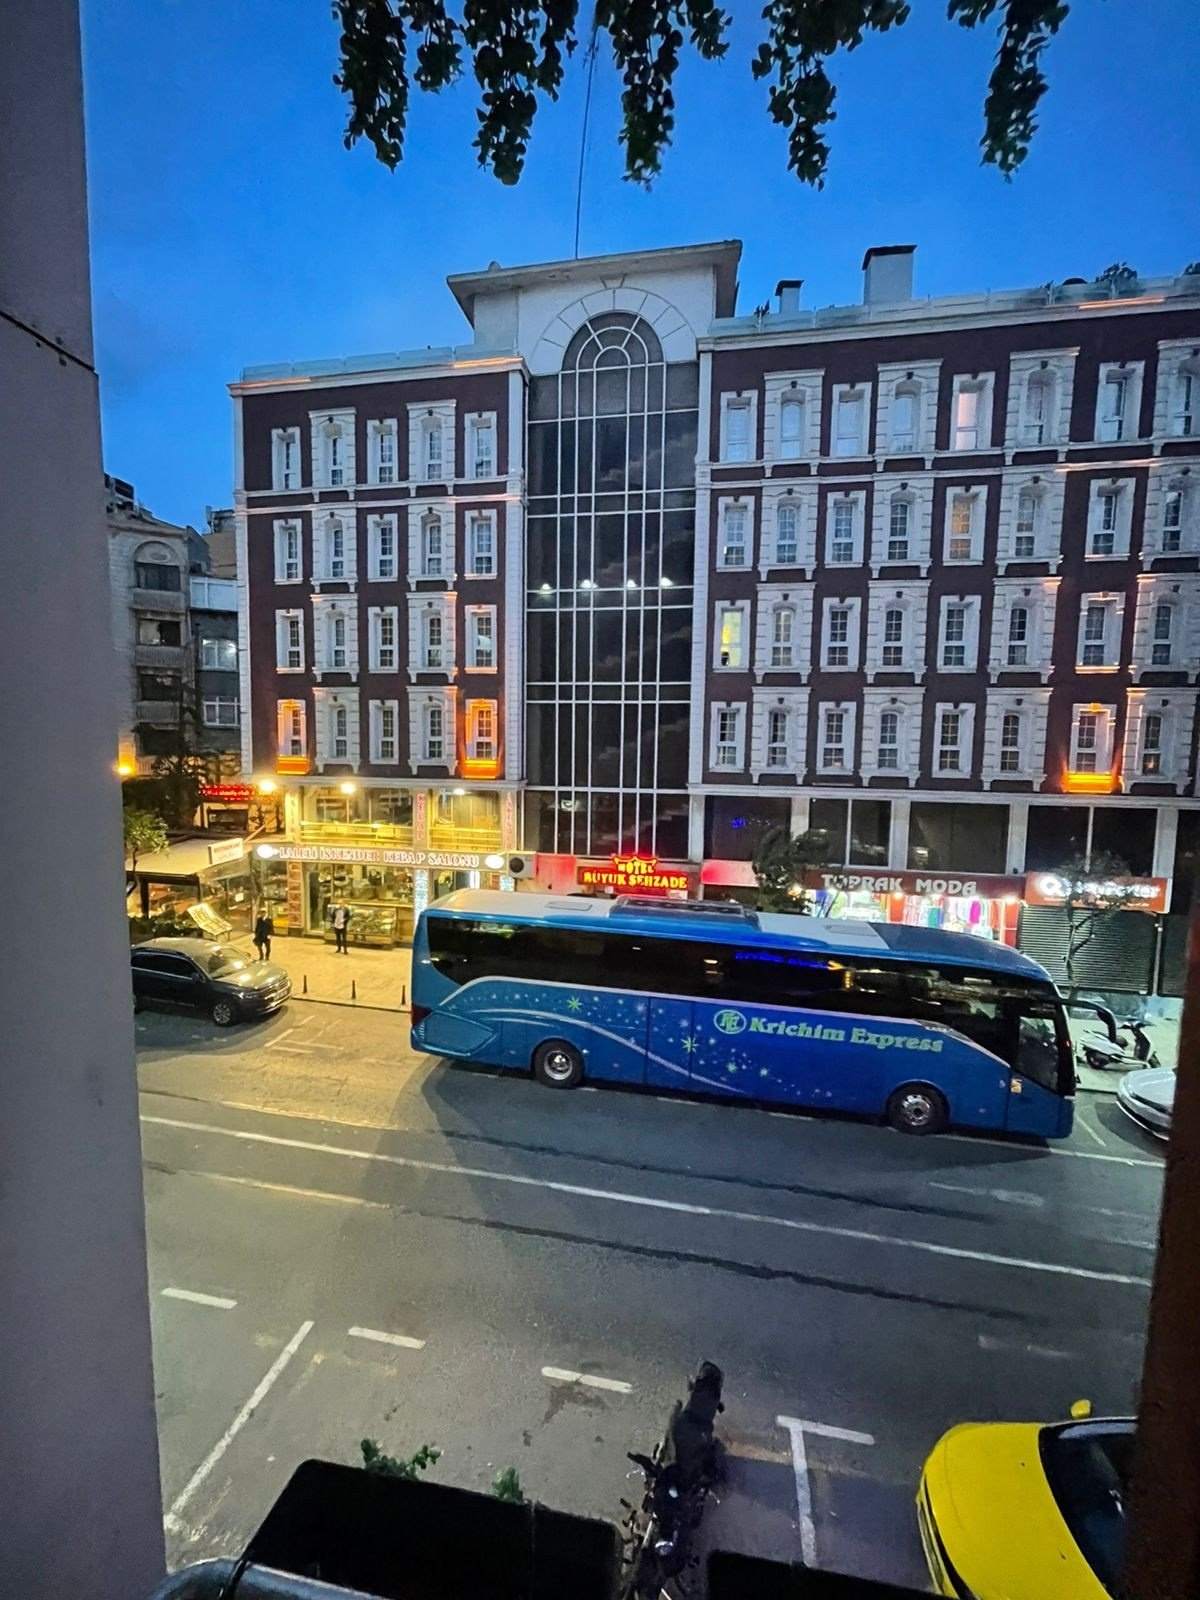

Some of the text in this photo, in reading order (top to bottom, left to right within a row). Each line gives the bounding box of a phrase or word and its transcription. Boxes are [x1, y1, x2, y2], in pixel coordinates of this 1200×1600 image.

[383, 850, 426, 864] KEBAP
[428, 853, 480, 868] SALONU
[617, 861, 655, 874] HOTEL
[821, 874, 977, 897] TOPRAK MODA
[748, 1016, 944, 1053] Krichim Express
